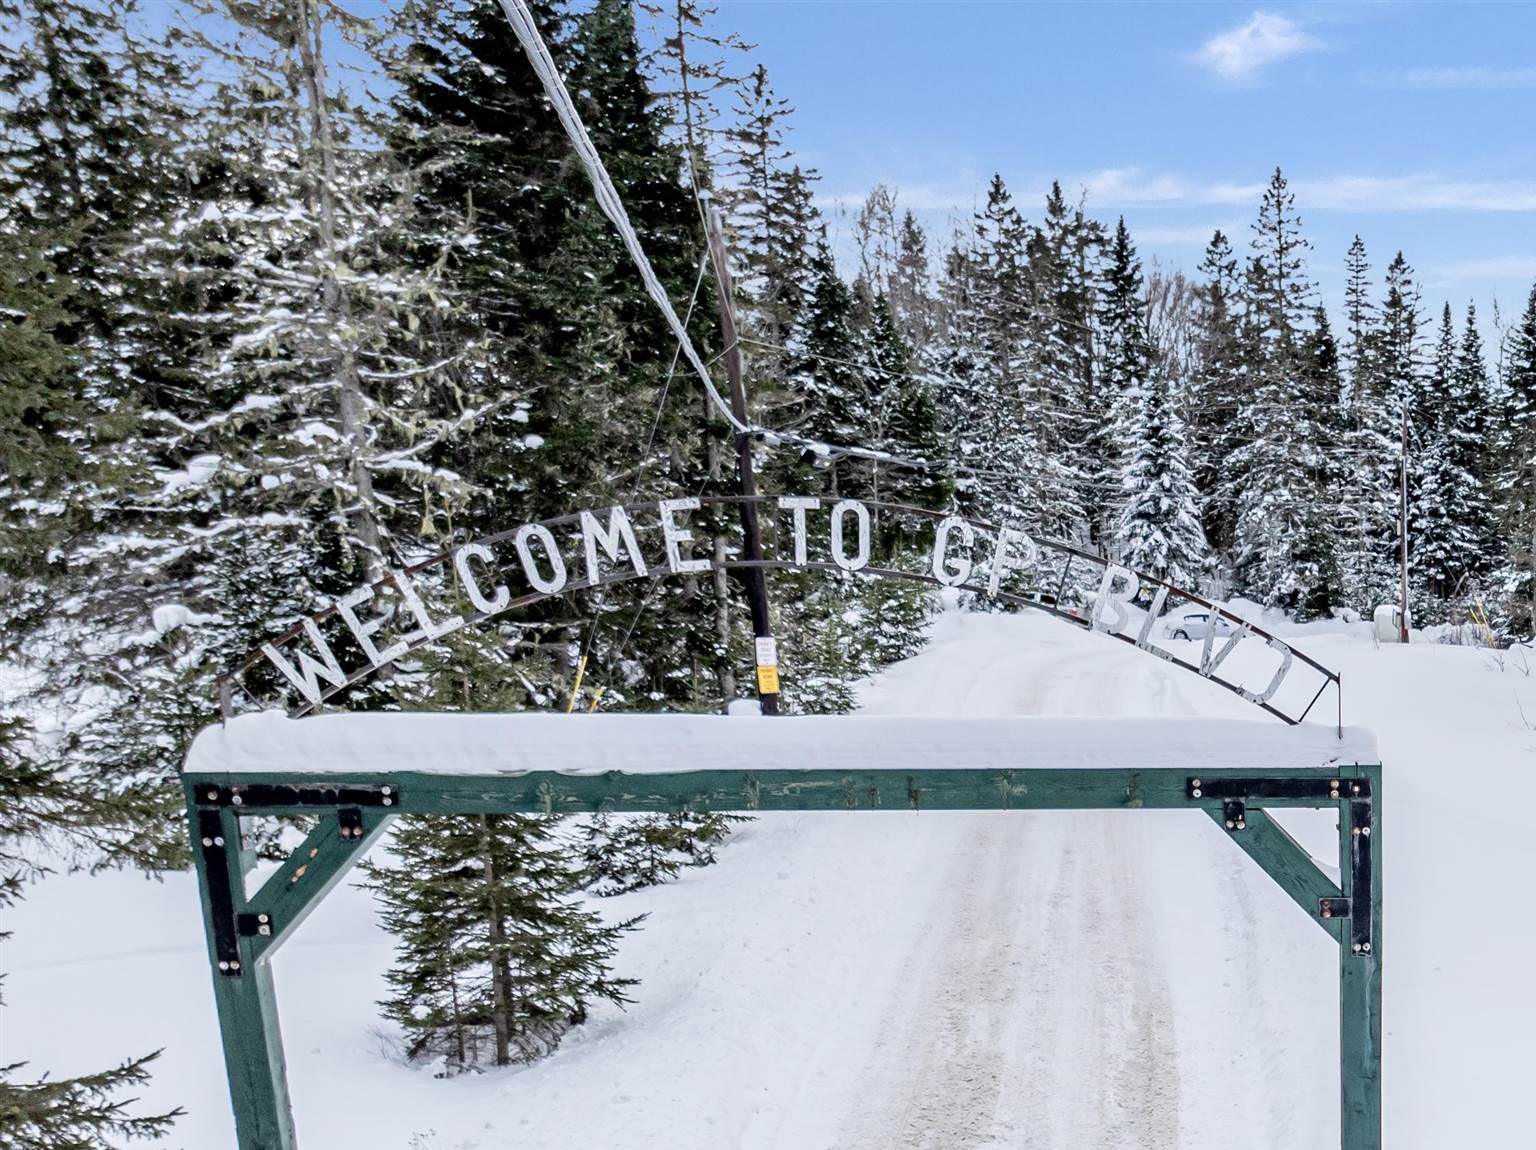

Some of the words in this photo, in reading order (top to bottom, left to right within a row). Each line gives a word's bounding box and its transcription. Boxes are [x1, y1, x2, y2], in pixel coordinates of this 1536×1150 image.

[262, 497, 710, 703] WELCOME
[779, 498, 870, 571] TO
[932, 516, 1037, 598] GP
